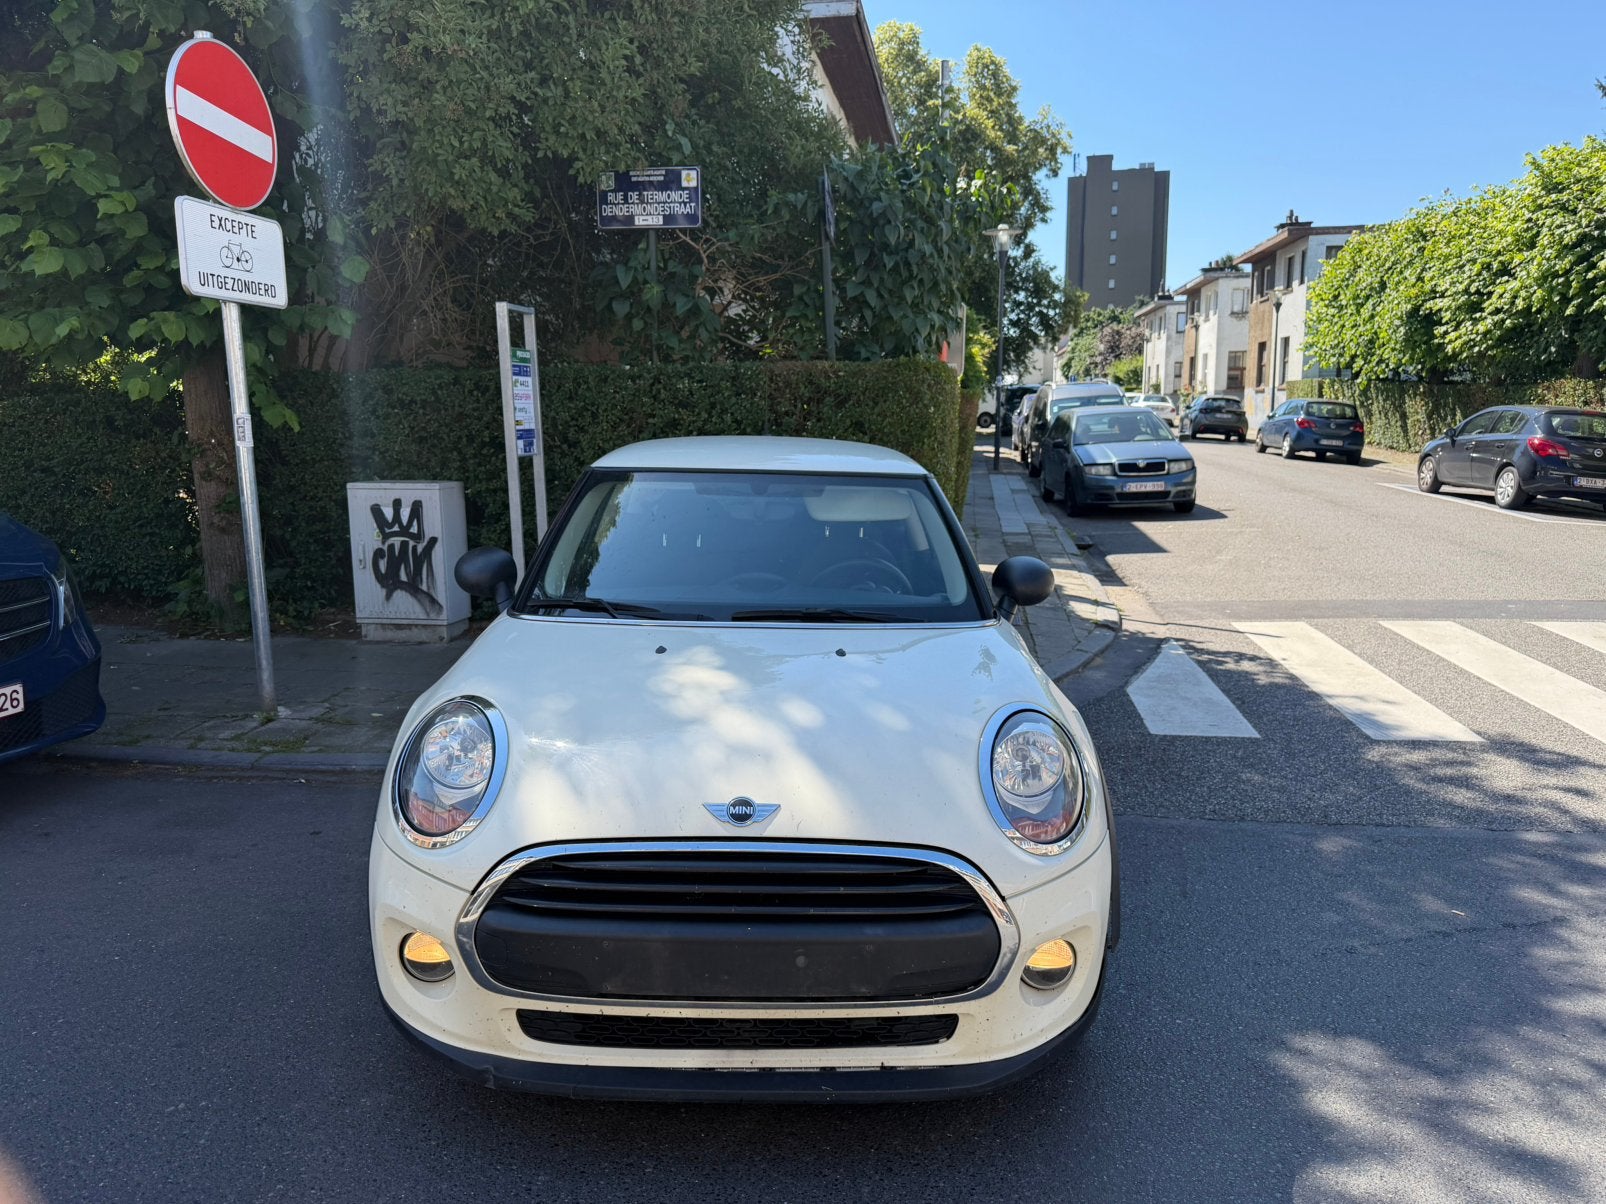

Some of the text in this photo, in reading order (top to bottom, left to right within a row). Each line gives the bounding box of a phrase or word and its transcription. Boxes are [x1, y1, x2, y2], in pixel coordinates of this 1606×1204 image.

[607, 190, 690, 203] RUE DE TERMONDE
[601, 203, 696, 216] DENDERMONDESTRAAT
[209, 213, 258, 239] EXCEPTE
[198, 271, 277, 298] UITGEZONDERD
[0, 690, 20, 712] 26
[729, 806, 754, 815] MINI
